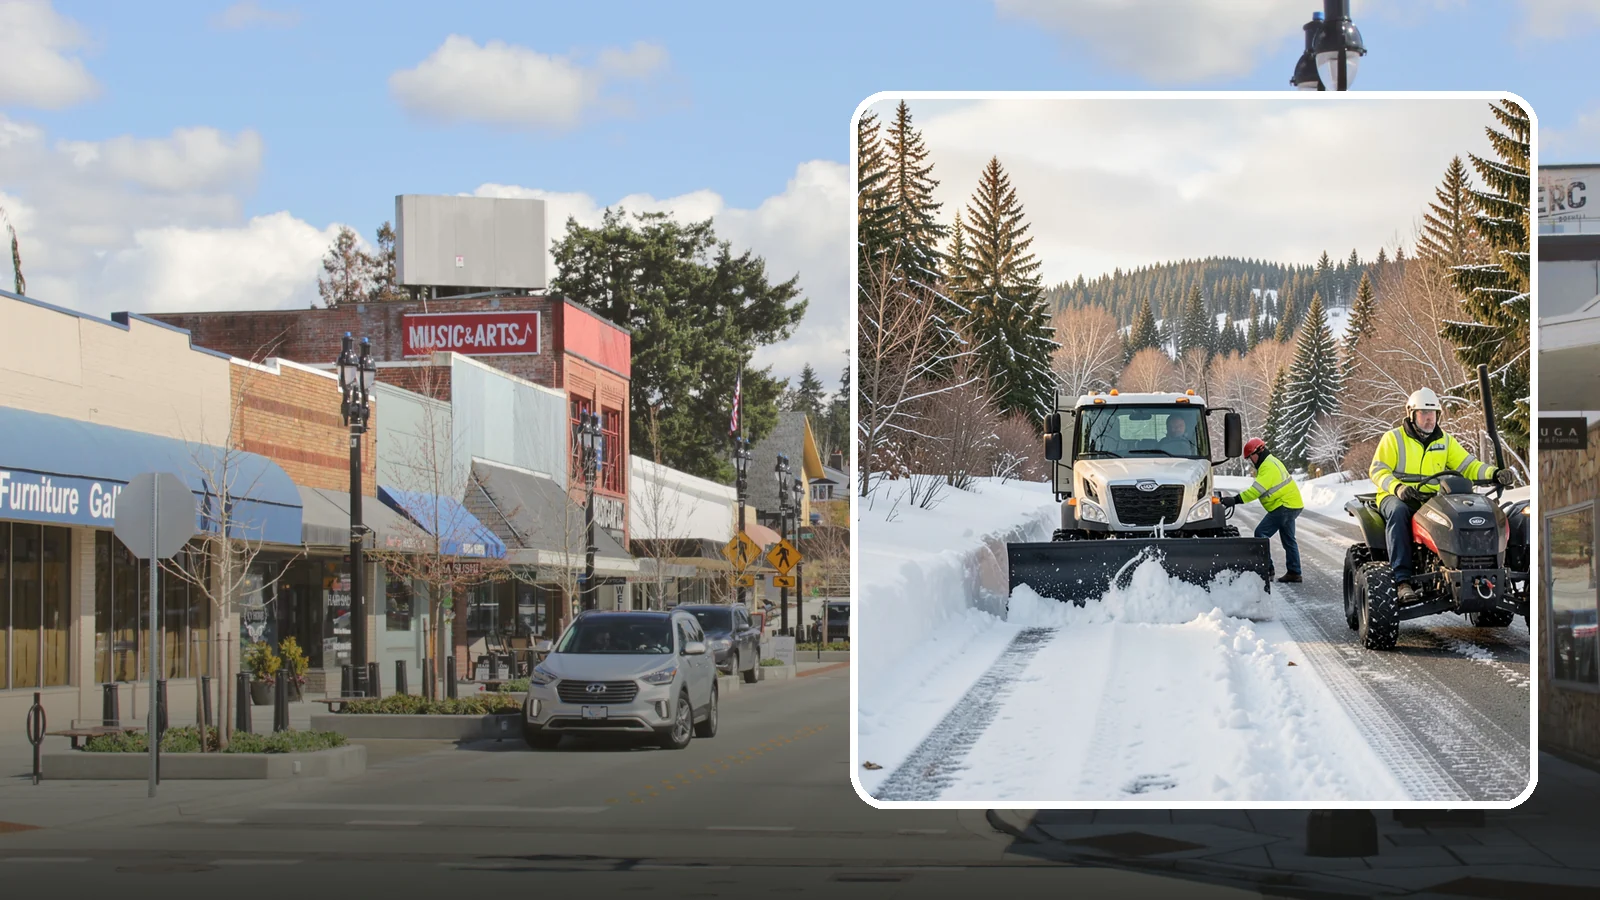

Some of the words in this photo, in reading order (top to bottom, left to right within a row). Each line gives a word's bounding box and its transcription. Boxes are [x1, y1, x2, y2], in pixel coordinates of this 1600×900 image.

[0, 471, 79, 515] Furniture
[89, 482, 122, 519] Gal
[453, 562, 480, 574] SUSHI
